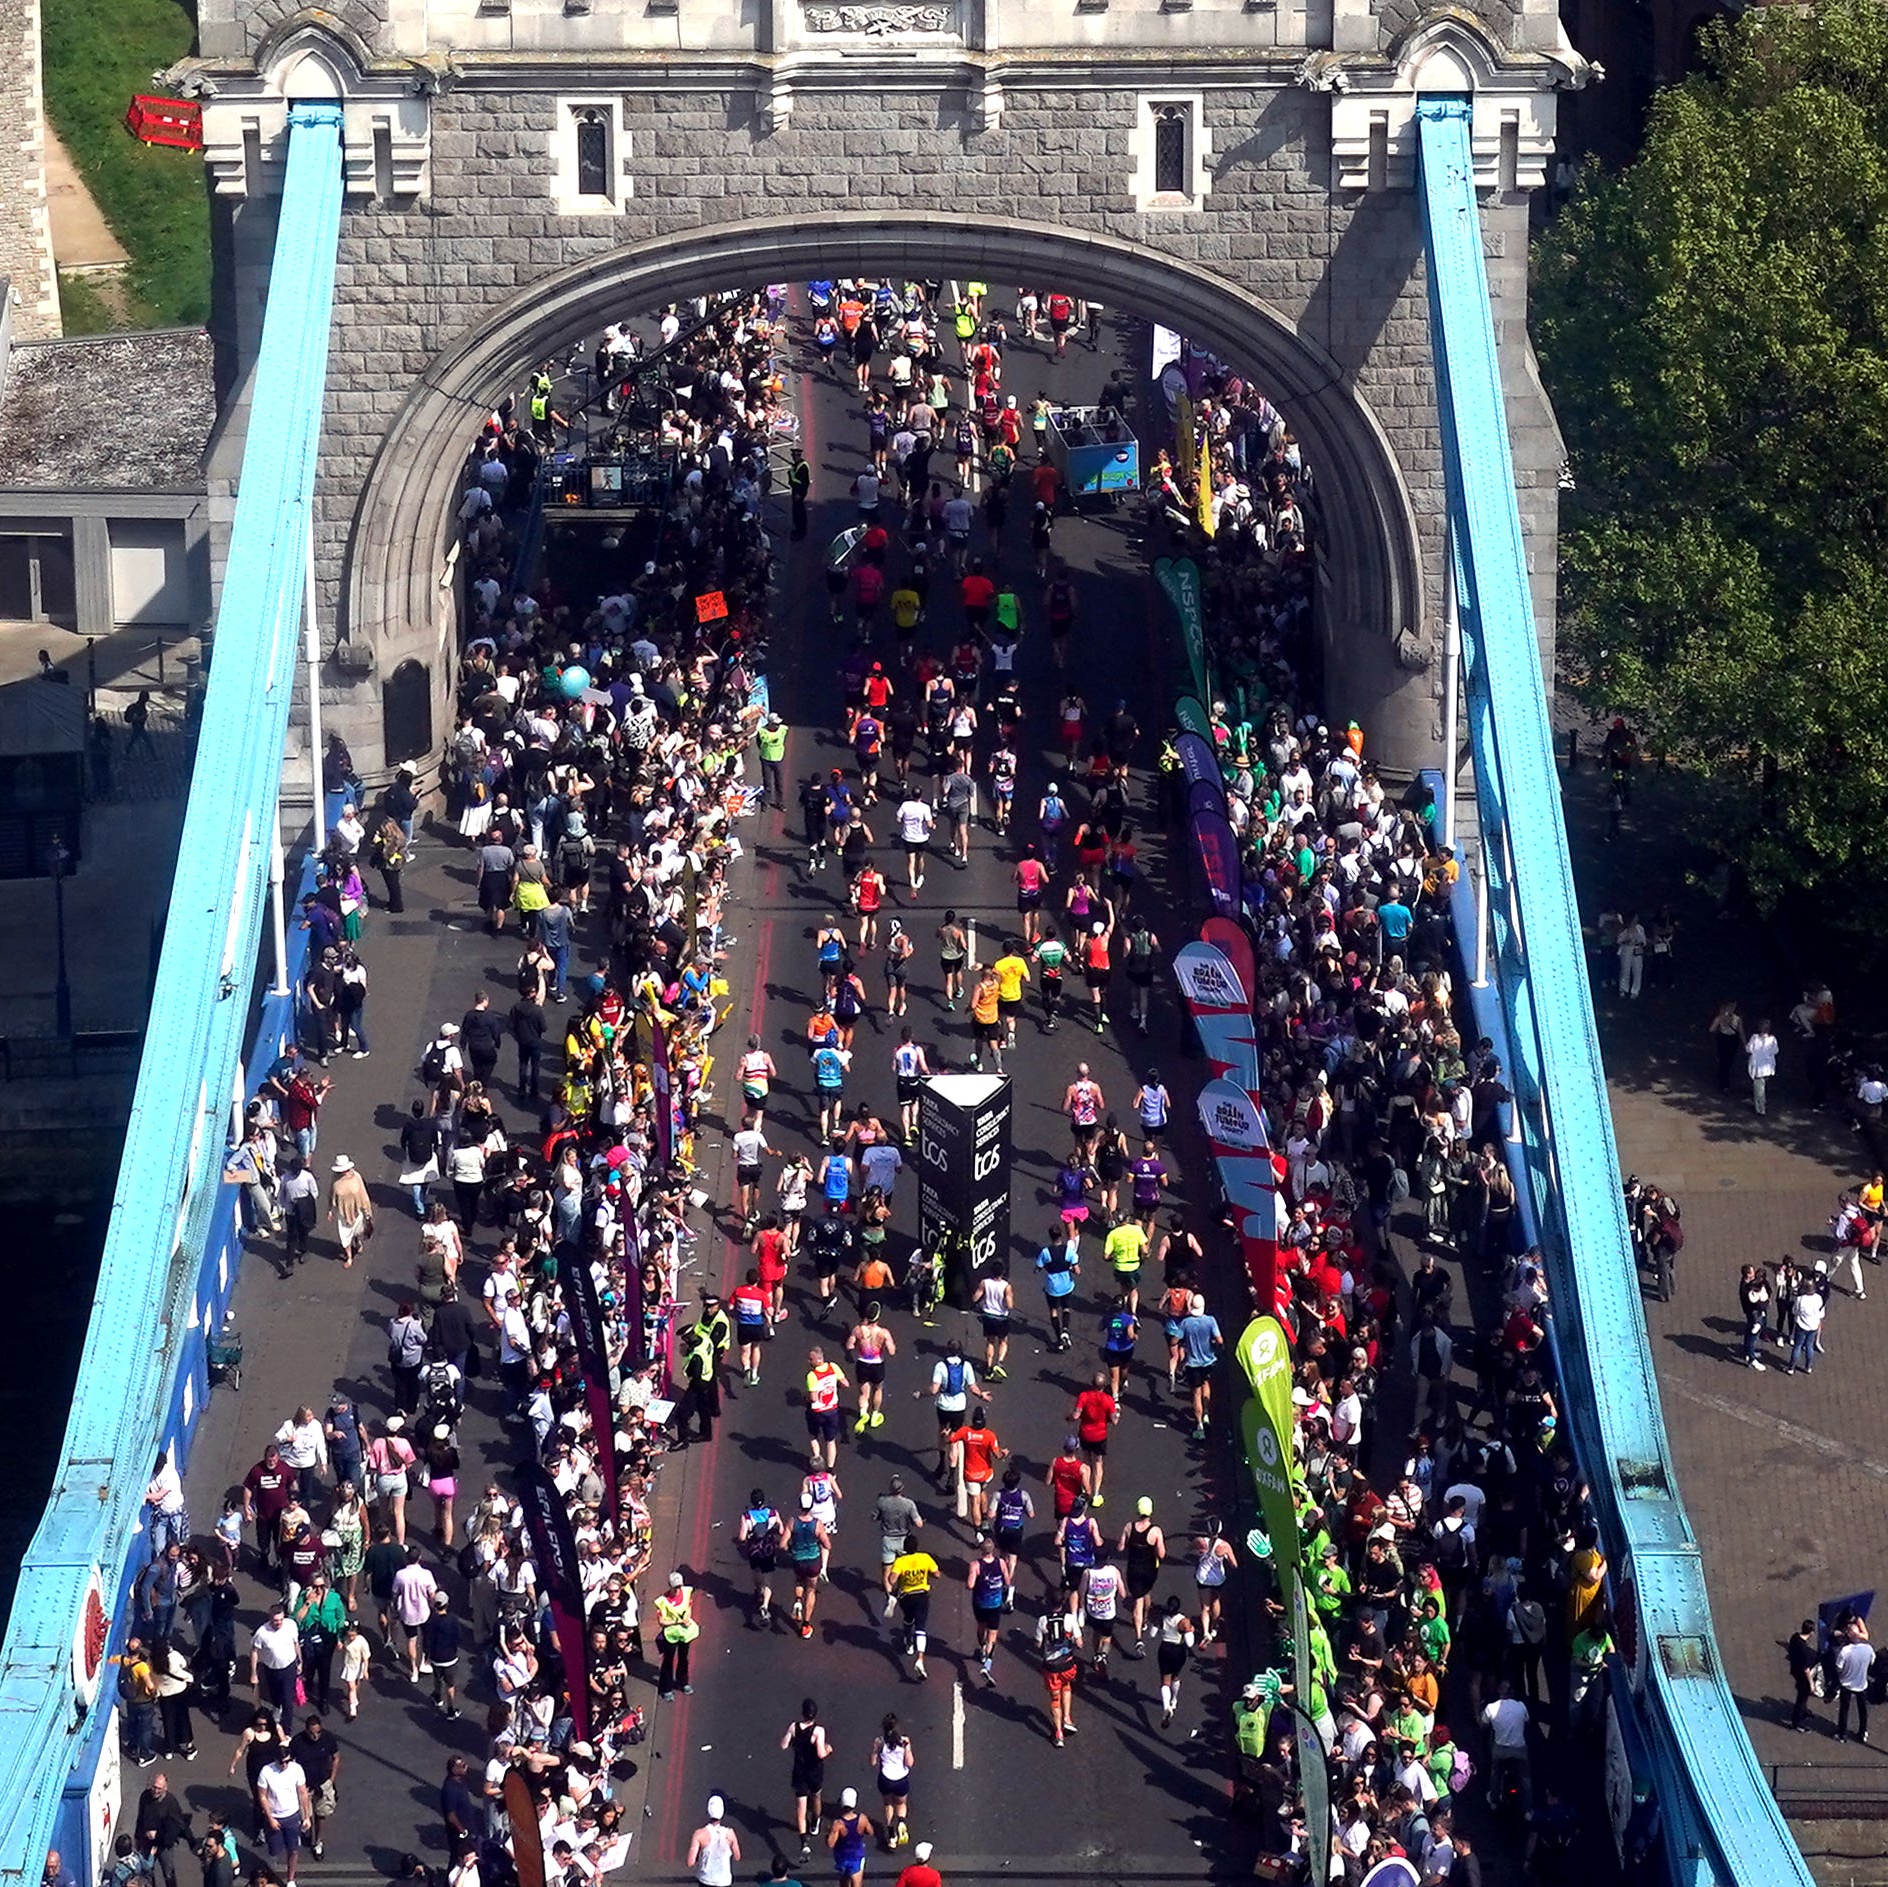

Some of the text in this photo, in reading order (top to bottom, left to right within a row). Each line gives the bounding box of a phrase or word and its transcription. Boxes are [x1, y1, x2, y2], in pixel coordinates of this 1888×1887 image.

[1178, 571, 1203, 657] NSPCC
[1192, 975, 1228, 990] TUMOUR
[1193, 966, 1222, 980] BRAIN
[921, 1095, 940, 1112] TATA
[1216, 1105, 1245, 1121] BRAIN
[1215, 1114, 1250, 1132] TUMOUR
[922, 1128, 948, 1172] tcs
[974, 1143, 1000, 1182] tcs
[921, 1183, 939, 1201] TATA
[921, 1203, 946, 1224] SERVICE
[971, 1230, 996, 1269] tcs
[571, 1266, 597, 1354] EPILEPSY
[1253, 1358, 1285, 1387] XFAM
[1255, 1467, 1286, 1494] OXFAM
[536, 1485, 569, 1582] EPILEPSY
